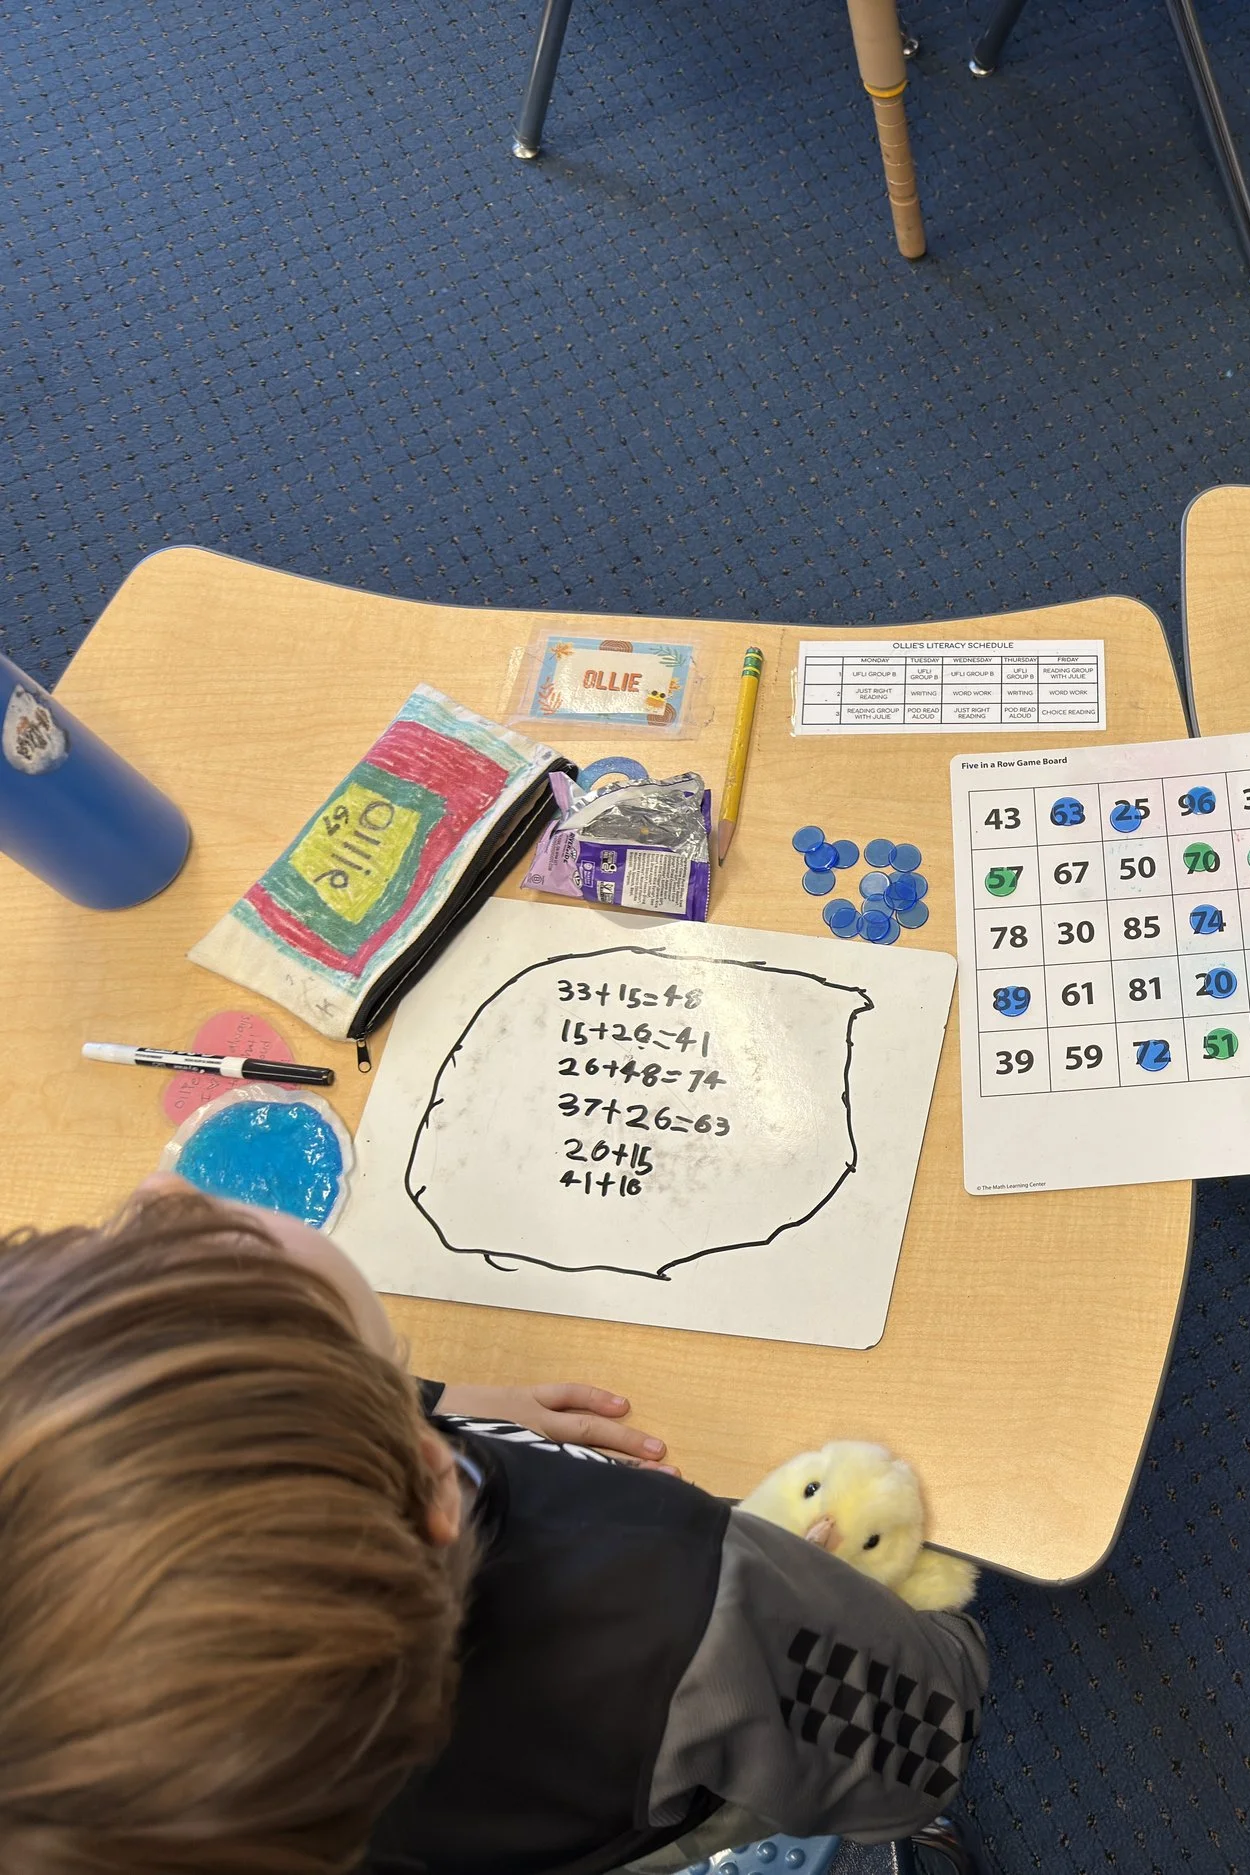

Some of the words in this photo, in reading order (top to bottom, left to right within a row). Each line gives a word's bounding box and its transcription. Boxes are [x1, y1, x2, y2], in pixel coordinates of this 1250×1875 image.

[583, 670, 642, 692] OLLIE
[984, 807, 1021, 830] 43
[1050, 803, 1085, 826] 63
[1115, 798, 1150, 821] 25
[1178, 792, 1215, 816] 96
[313, 800, 395, 889] Ollie
[988, 866, 1024, 889] 57
[1053, 861, 1089, 884] 67
[1119, 857, 1156, 880] 50
[1183, 850, 1221, 875] 70
[990, 925, 1028, 950] 78
[1057, 920, 1095, 945] 30
[1123, 916, 1161, 940] 85
[1189, 911, 1226, 935] 74
[558, 980, 703, 1009] 33+15=48
[992, 987, 1030, 1011] 89
[1061, 982, 1094, 1006] 61
[1128, 977, 1162, 1001] 81
[1195, 971, 1233, 996] 20
[561, 1019, 710, 1057] 15+26=41
[996, 1050, 1035, 1075] 39
[1065, 1045, 1103, 1070] 59
[1132, 1040, 1170, 1065] 72
[1202, 1034, 1235, 1059] 51
[558, 1057, 727, 1093] 26+48=74
[558, 1093, 730, 1136] 37+26=63
